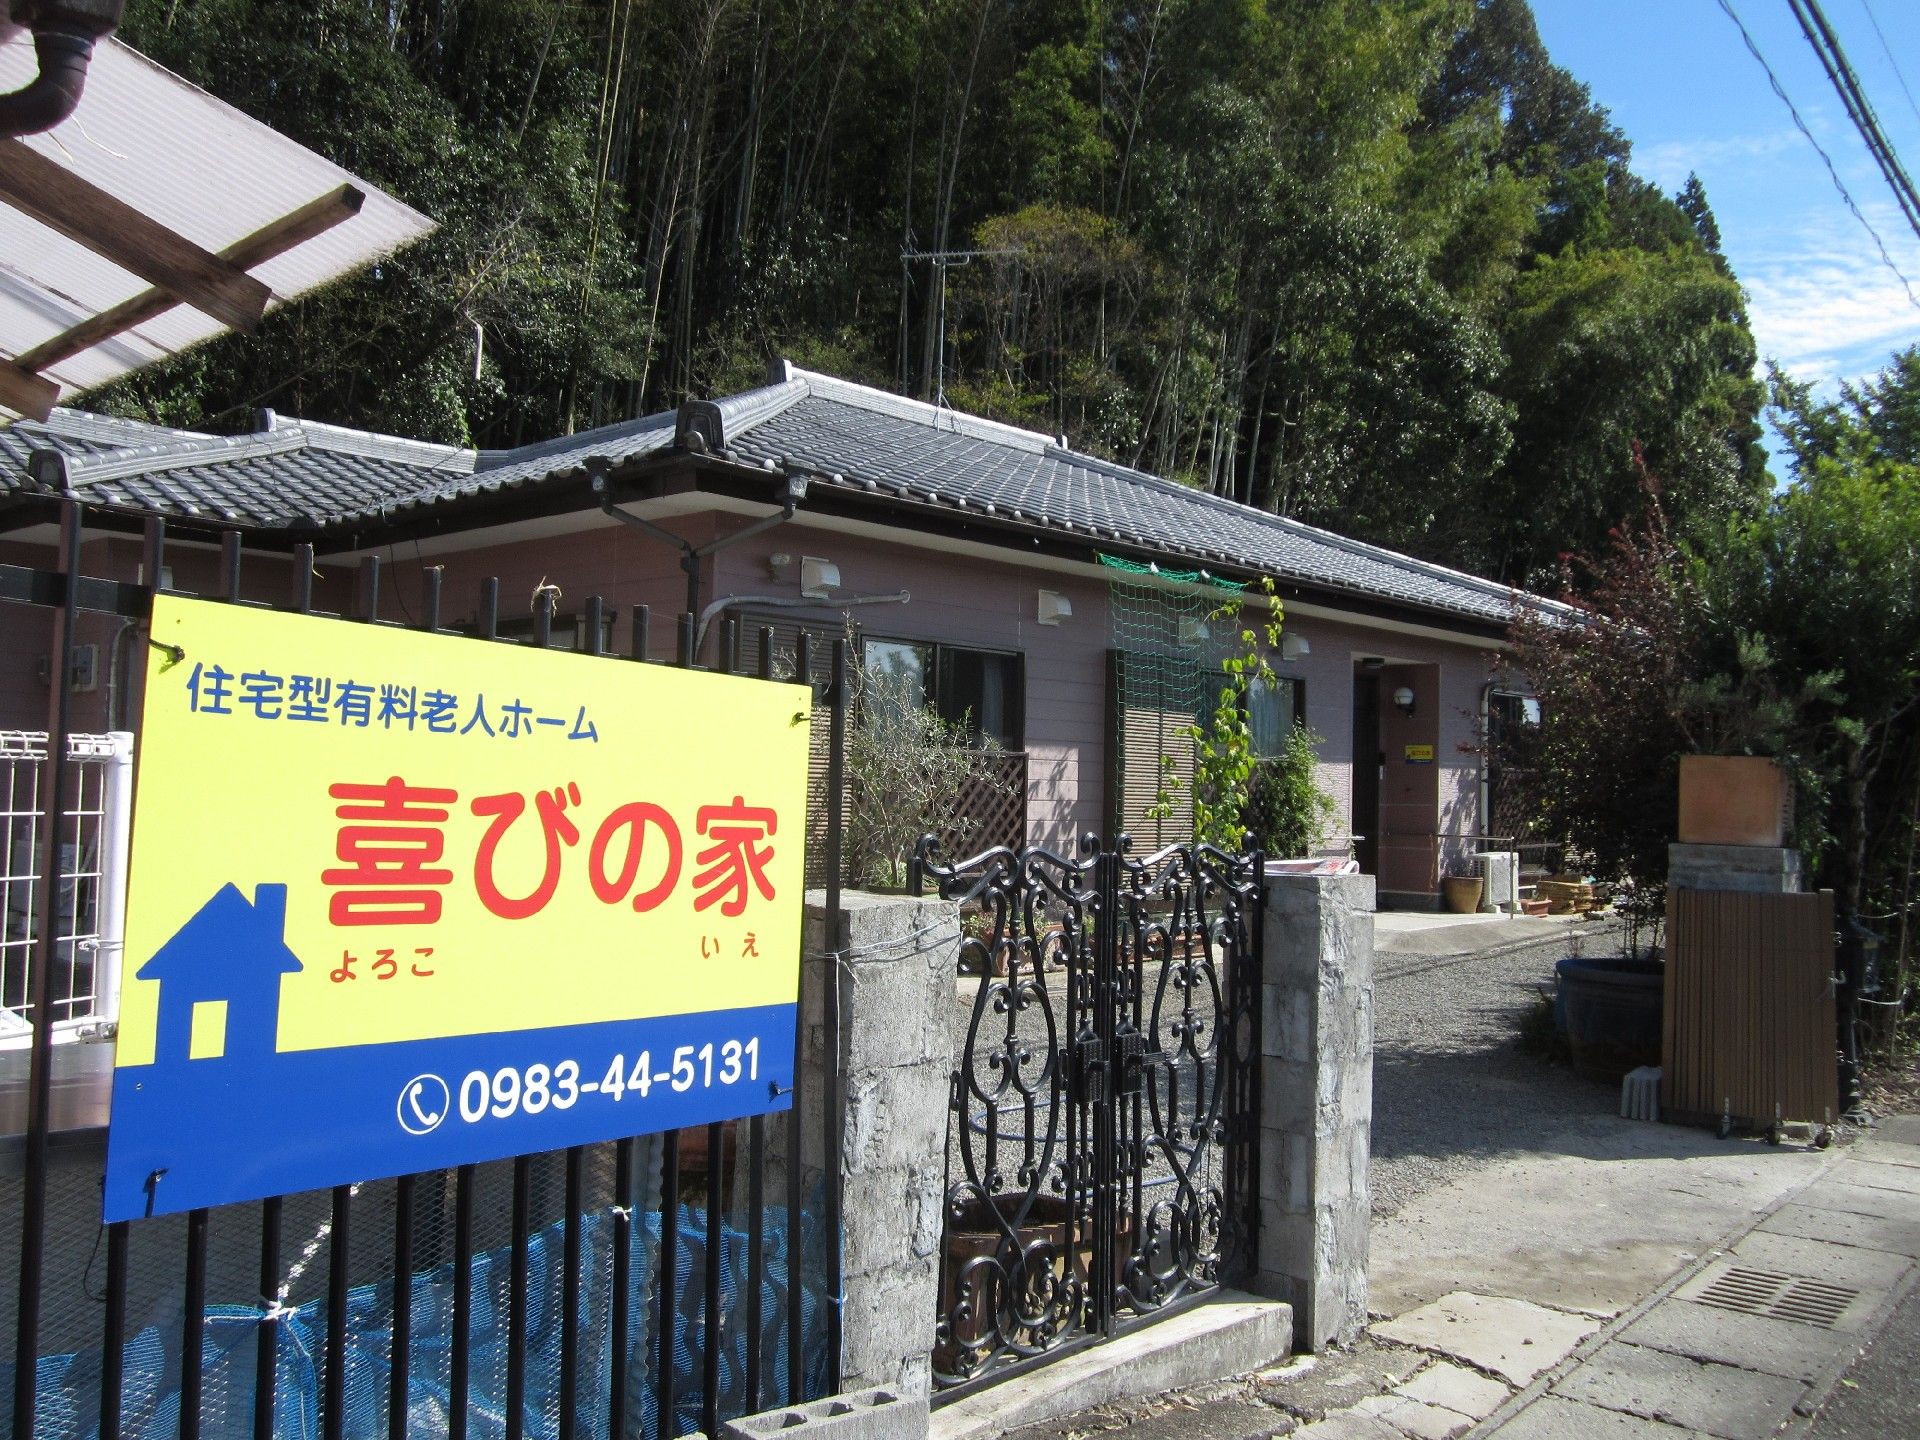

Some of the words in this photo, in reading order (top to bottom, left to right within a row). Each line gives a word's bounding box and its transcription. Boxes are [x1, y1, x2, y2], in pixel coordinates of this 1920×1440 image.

[186, 662, 599, 743] 住宅型有料老人ホーム
[321, 776, 777, 926] 喜びの家
[329, 947, 435, 983] よろこ
[701, 932, 760, 959] いえ
[457, 1036, 760, 1124] 0983-44-5131
